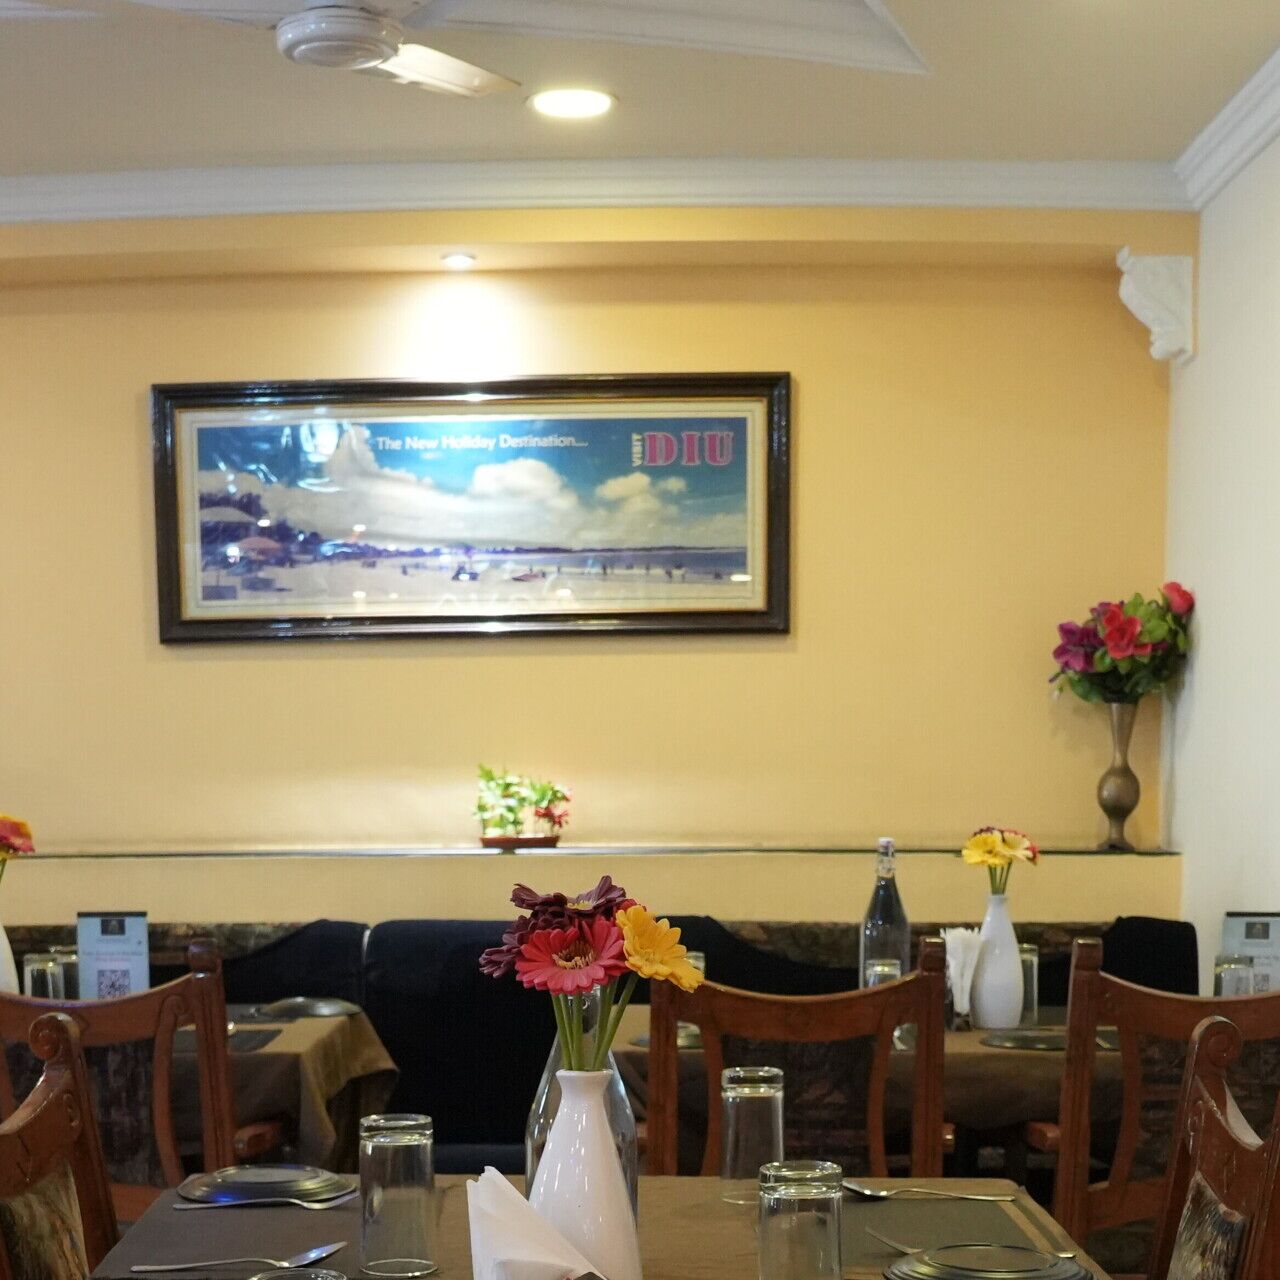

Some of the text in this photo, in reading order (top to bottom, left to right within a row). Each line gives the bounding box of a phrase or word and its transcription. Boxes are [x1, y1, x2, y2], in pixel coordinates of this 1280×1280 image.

[376, 437, 402, 450] The
[405, 436, 439, 450] New
[442, 435, 496, 452] Holiday
[643, 431, 734, 466] DIU
